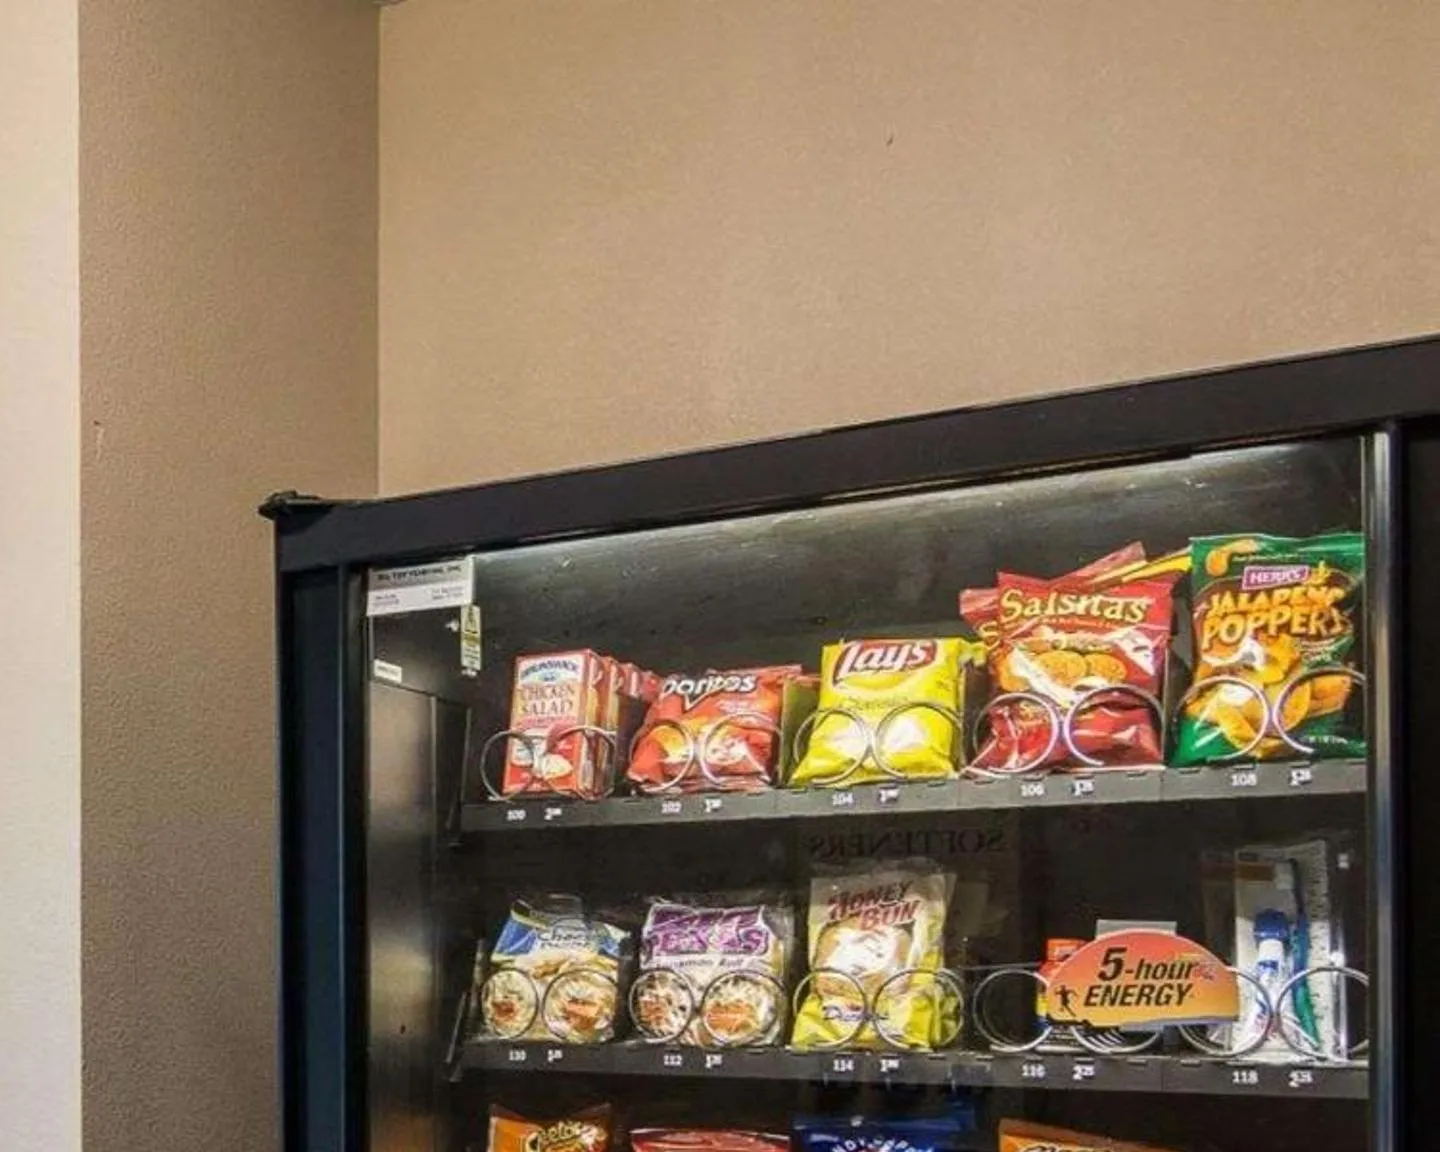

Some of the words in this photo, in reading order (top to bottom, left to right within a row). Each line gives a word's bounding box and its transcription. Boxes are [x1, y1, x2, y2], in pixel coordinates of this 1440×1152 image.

[1000, 588, 1149, 623] Salsitas
[519, 684, 575, 698] CHICKEN
[520, 701, 574, 716] SALAD
[1231, 773, 1257, 788] 108
[827, 880, 914, 918] HONEY
[861, 899, 921, 930] BUN
[1097, 946, 1196, 982] 5-hour
[1082, 982, 1194, 1008] ENERGY
